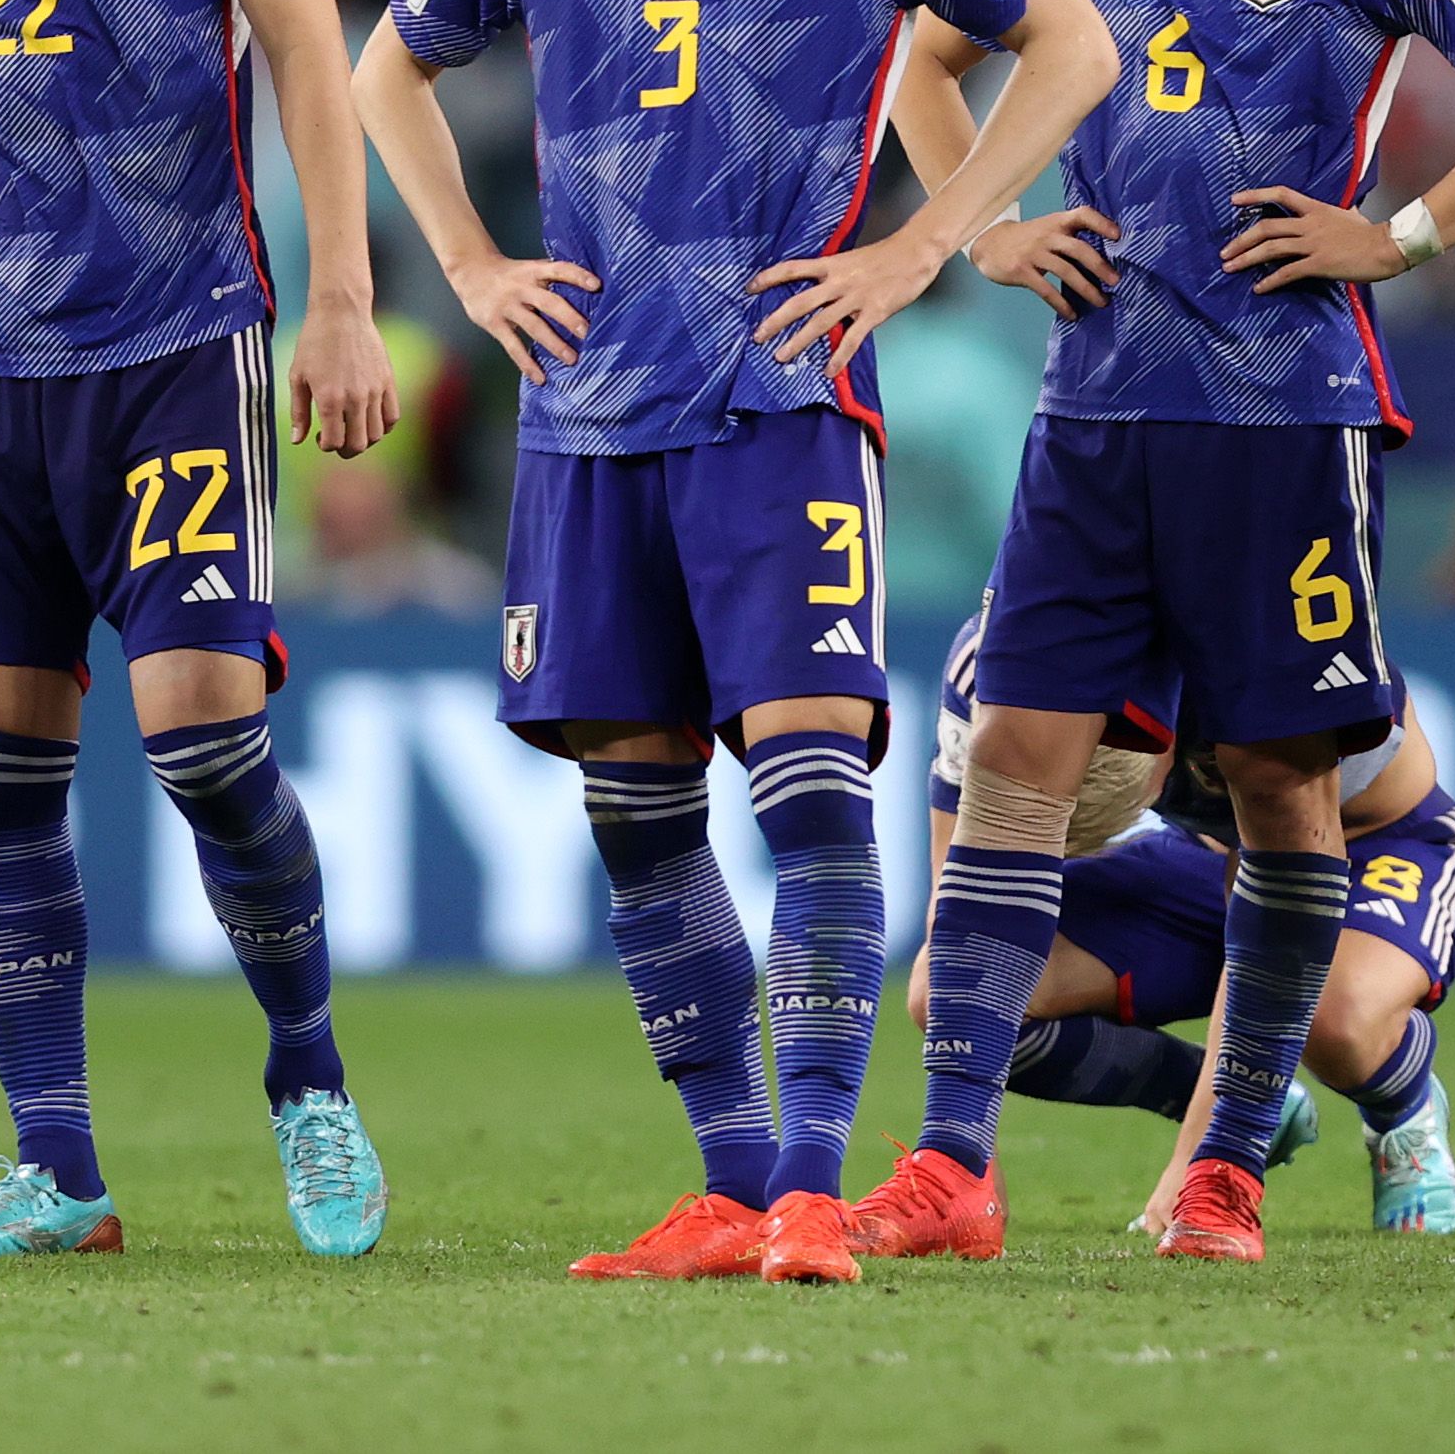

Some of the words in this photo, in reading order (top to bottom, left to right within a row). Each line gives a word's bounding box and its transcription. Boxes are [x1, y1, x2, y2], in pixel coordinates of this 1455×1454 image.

[639, 0, 700, 109] 3
[1146, 13, 1206, 113] 6
[124, 448, 238, 570] 22
[806, 501, 866, 605] 3
[1290, 537, 1354, 643] 6
[1348, 855, 1424, 903] 8
[769, 994, 874, 1016] JAPAN
[923, 1039, 973, 1055] PAN
